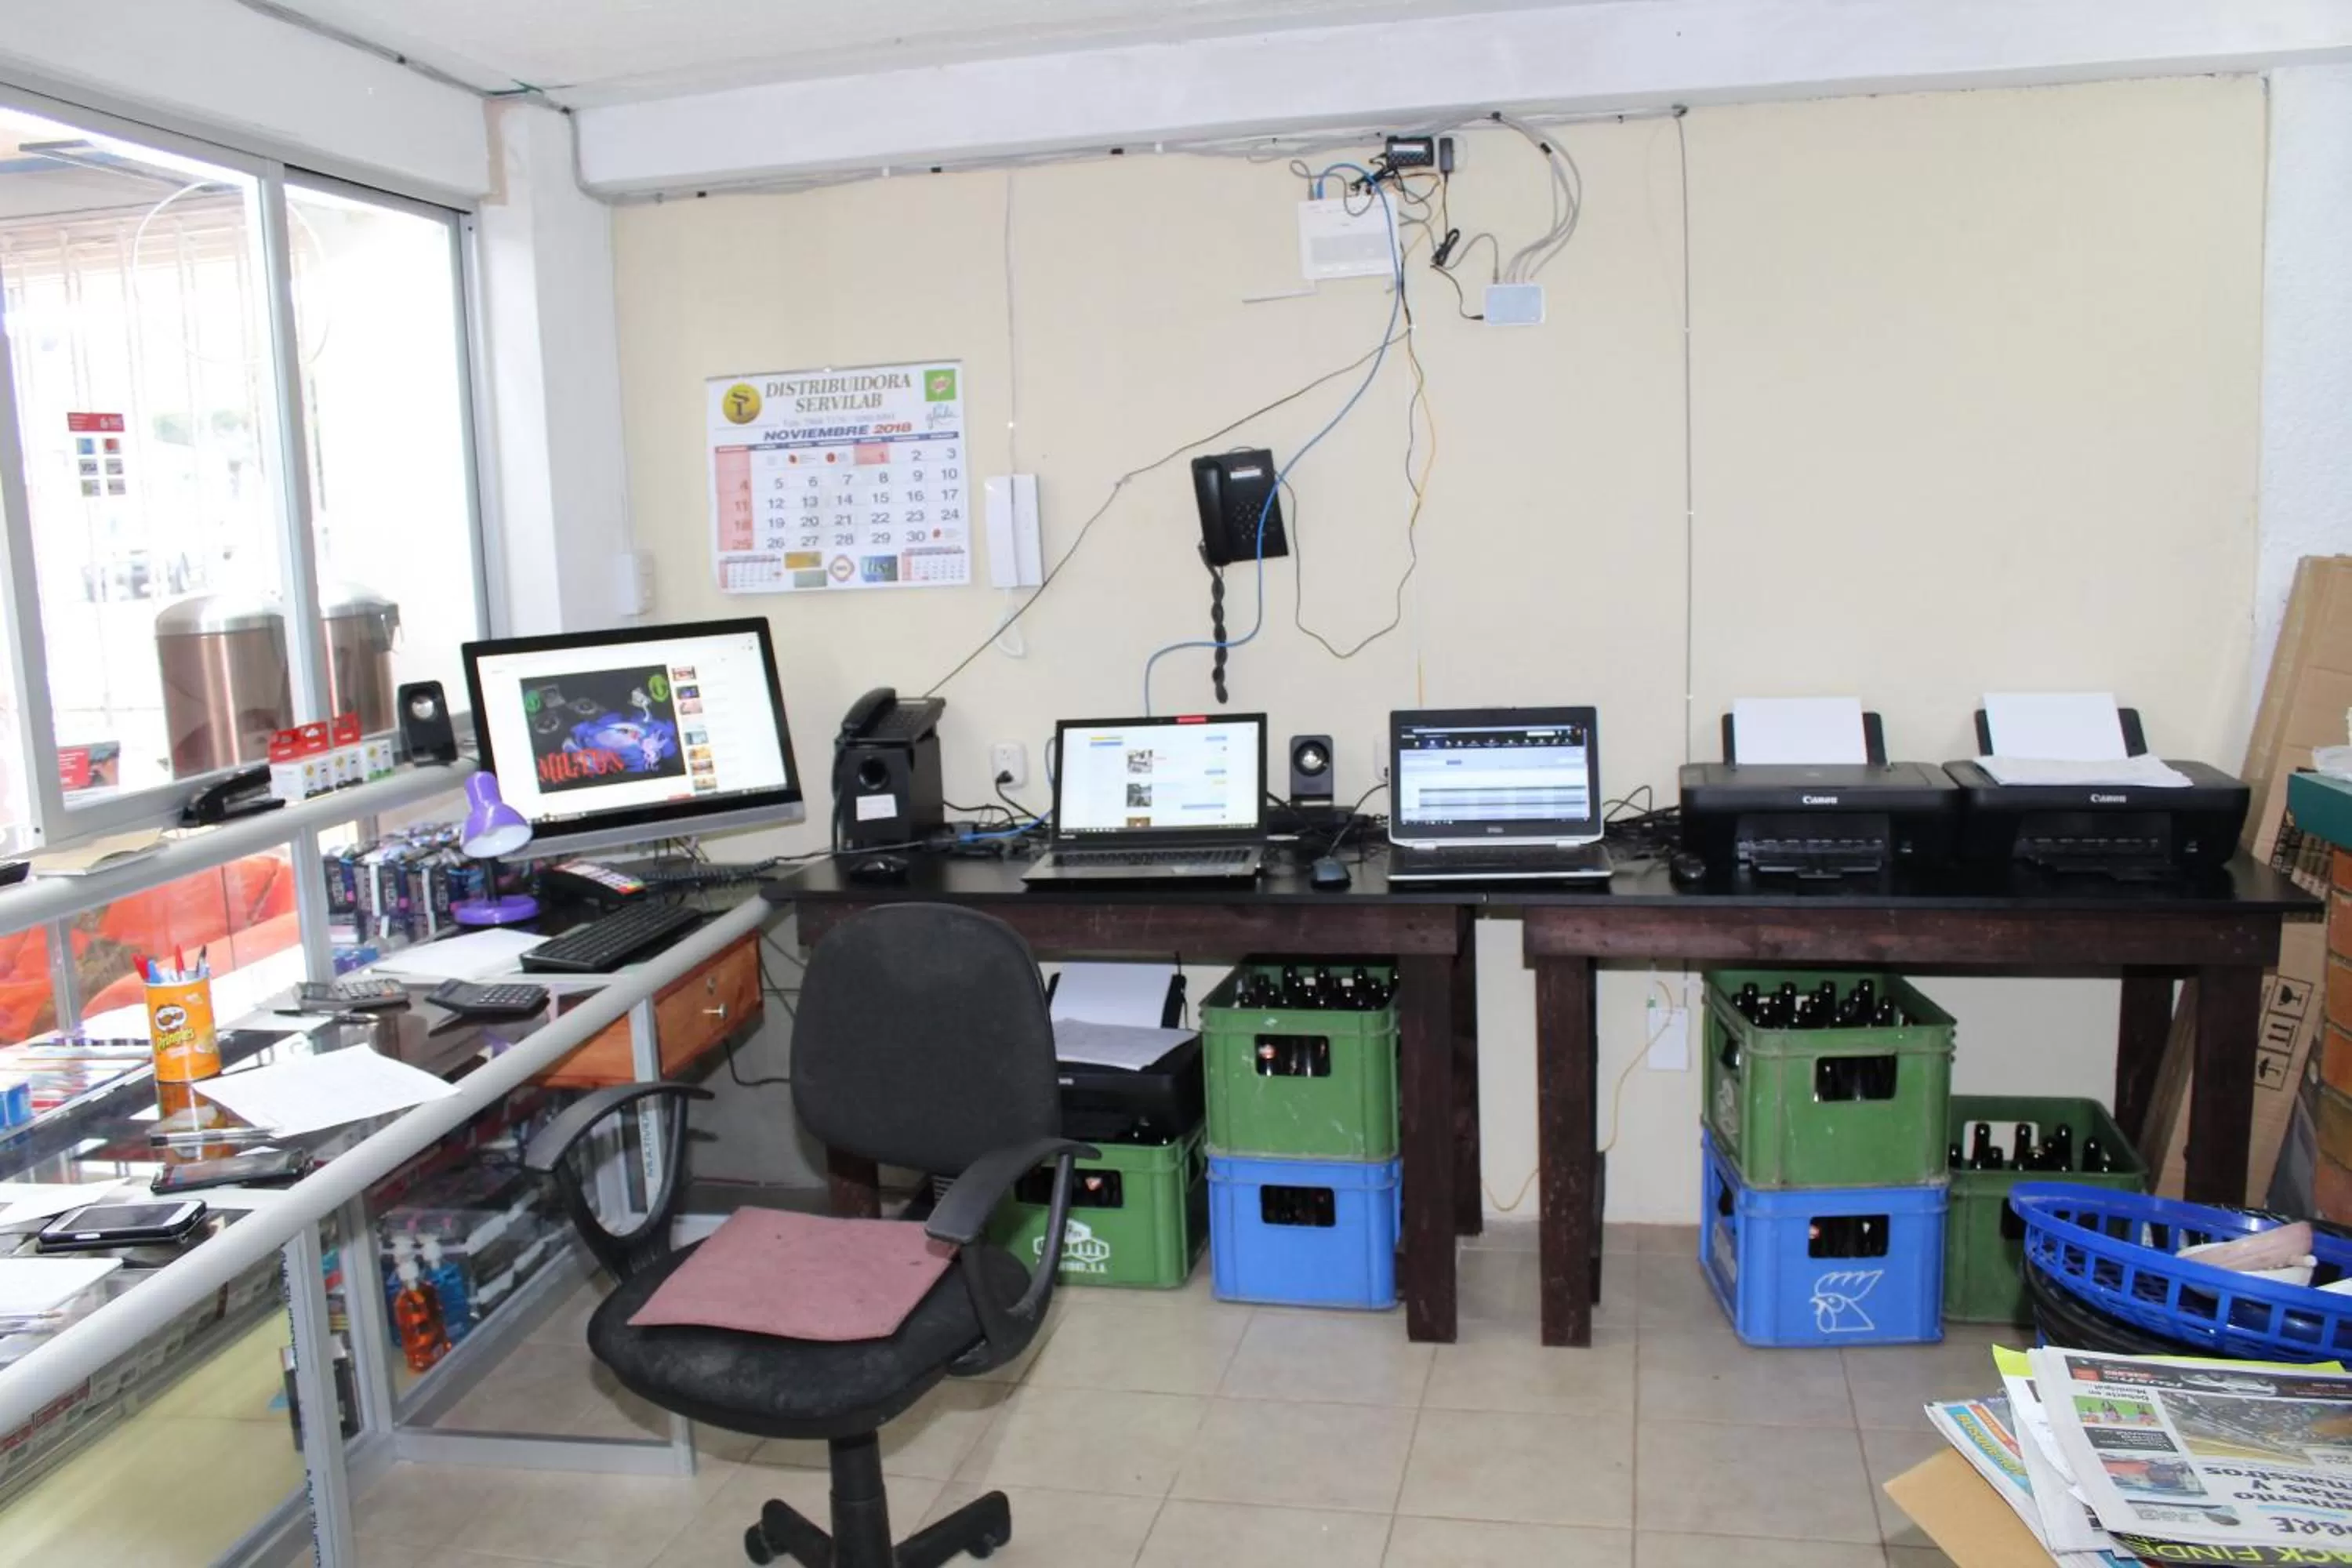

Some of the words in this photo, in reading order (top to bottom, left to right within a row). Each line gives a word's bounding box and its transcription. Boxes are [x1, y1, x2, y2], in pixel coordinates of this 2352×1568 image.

[764, 372, 912, 398] DISTRIBUIDORA
[794, 392, 883, 414] SERVILAB
[764, 424, 869, 441] NOVIEMBRE
[873, 422, 913, 434] 2018
[911, 449, 922, 461] 2
[946, 448, 956, 459] 3
[775, 478, 784, 489] 5
[808, 476, 818, 487] 6
[842, 474, 853, 485] 7
[879, 472, 889, 484] 8
[913, 470, 924, 482] 9
[942, 468, 958, 480] 10
[768, 498, 785, 509] 12
[802, 495, 818, 507] 13
[837, 494, 853, 506] 14
[872, 492, 890, 503] 15
[906, 490, 924, 502] 16
[942, 488, 959, 501] 17
[768, 517, 786, 528] 19
[800, 516, 819, 528] 20
[834, 514, 852, 525] 21
[871, 512, 891, 524] 22
[906, 510, 925, 522] 23
[941, 508, 960, 521] 24
[767, 537, 785, 549] 26
[800, 535, 819, 546] 27
[834, 532, 854, 546] 28
[871, 532, 891, 543] 29
[906, 530, 926, 543] 30
[1802, 795, 1838, 806] Canon
[2090, 793, 2127, 804] Canon
[158, 1028, 194, 1051] Pringles
